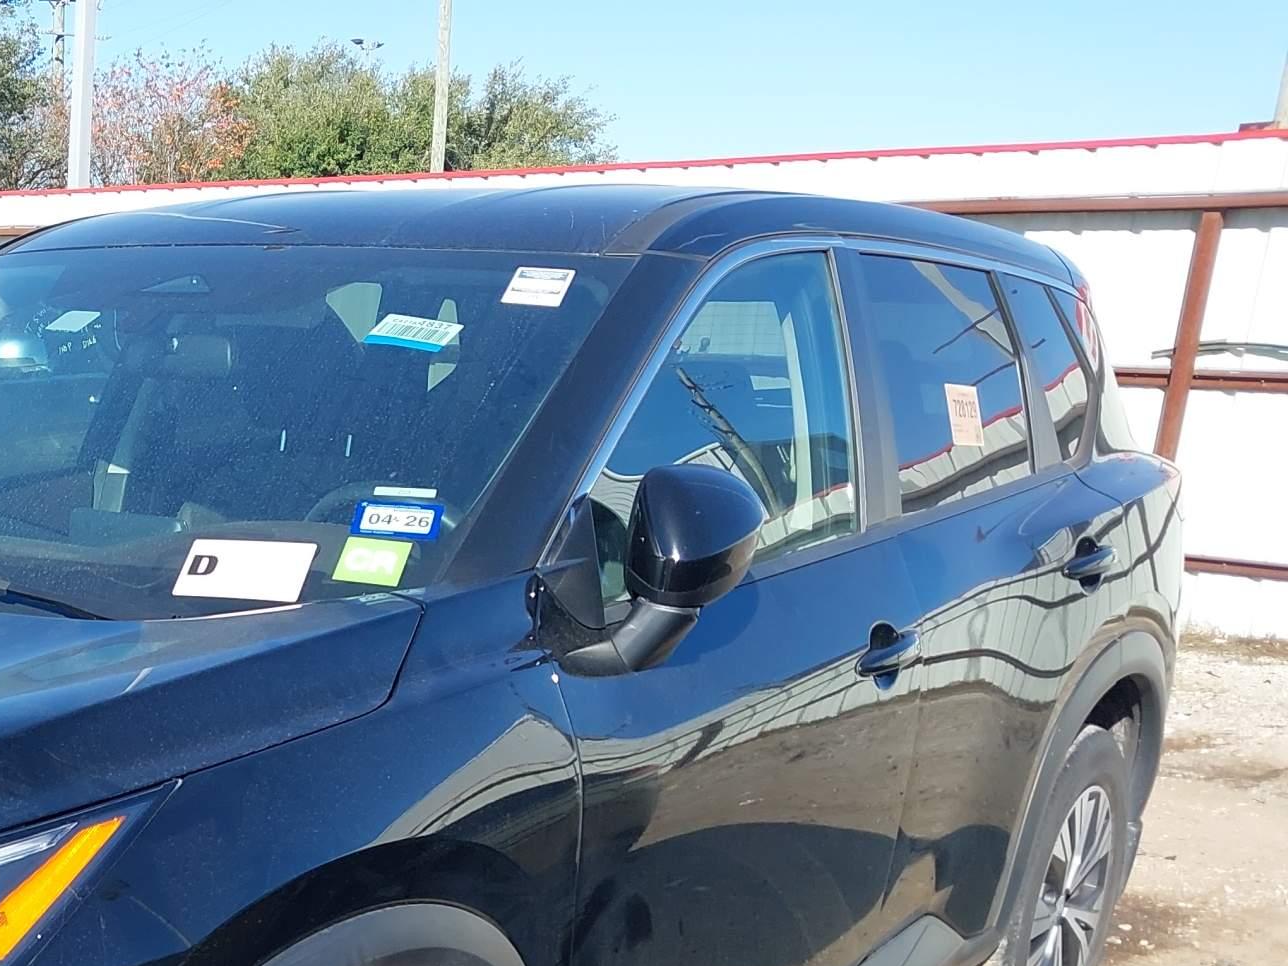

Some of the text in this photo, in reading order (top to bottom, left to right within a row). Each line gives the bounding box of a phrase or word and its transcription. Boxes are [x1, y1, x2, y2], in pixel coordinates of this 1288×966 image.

[368, 512, 431, 528] 04 26
[187, 554, 220, 576] D
